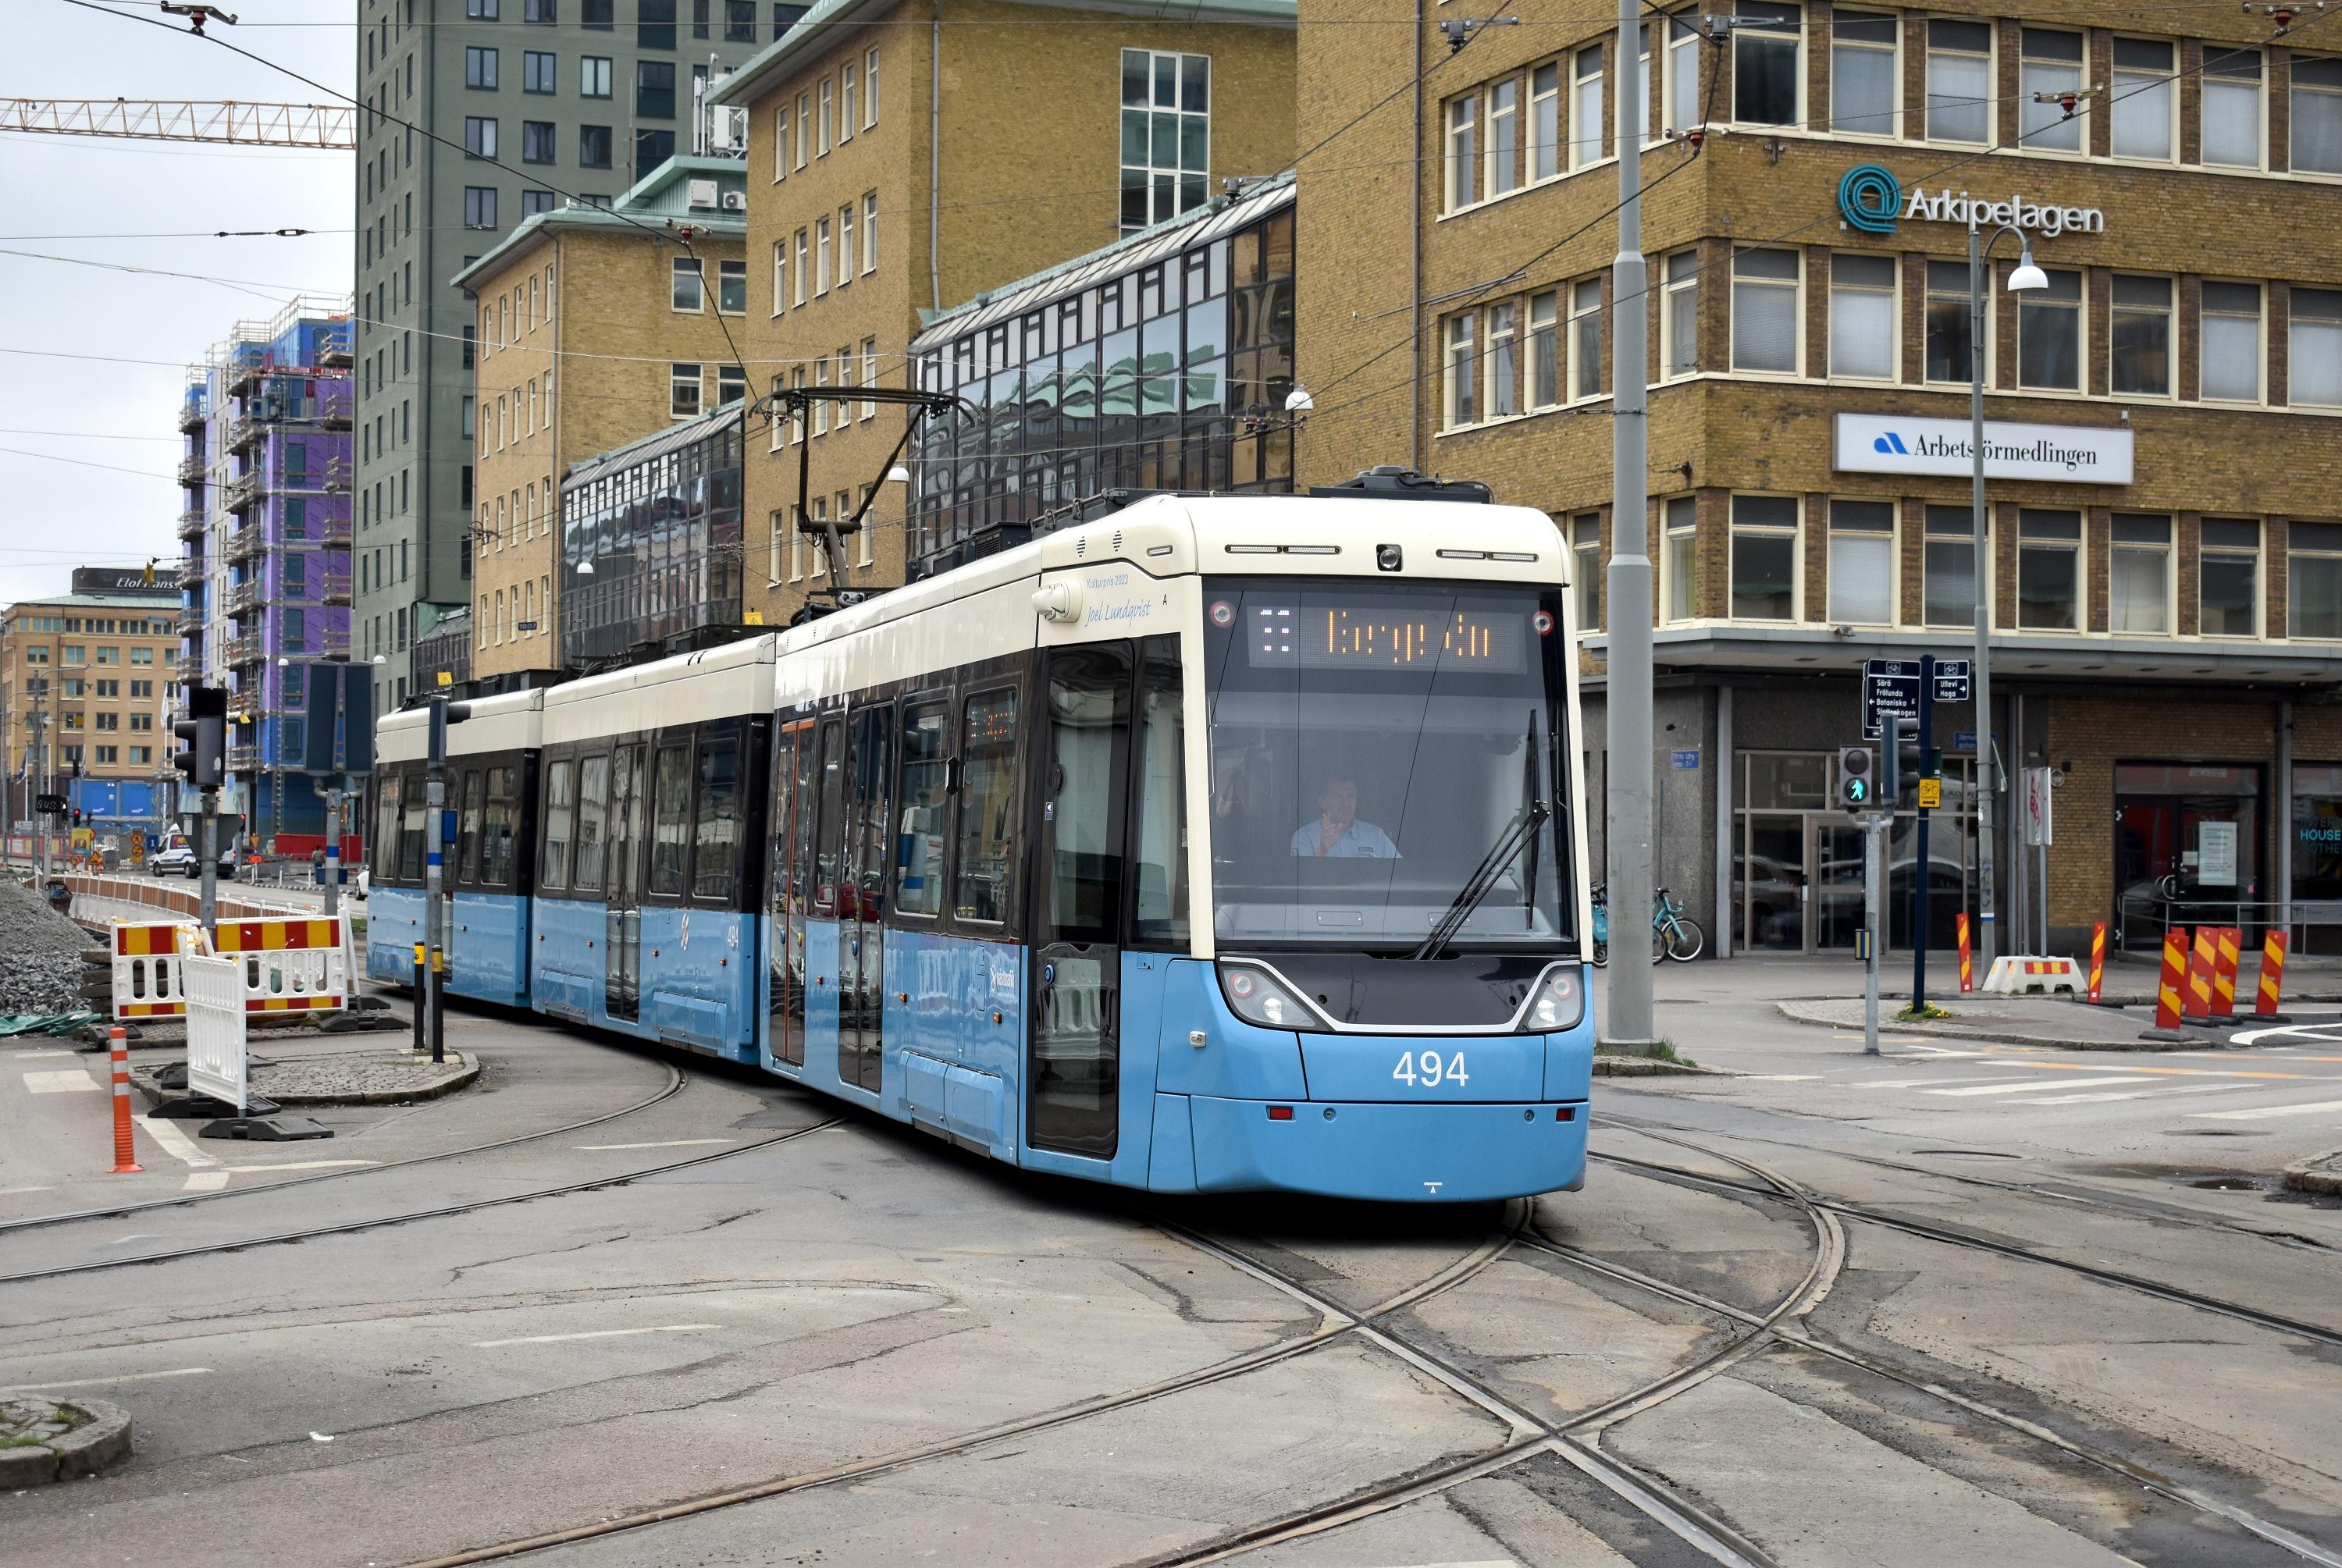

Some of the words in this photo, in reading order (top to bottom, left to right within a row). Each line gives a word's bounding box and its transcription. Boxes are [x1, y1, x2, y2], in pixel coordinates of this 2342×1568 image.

[1904, 187, 2104, 239] Arkipelagen
[1914, 433, 2098, 472] Arbetsörmedlingen
[1087, 576, 1115, 590] Kulturpris
[1115, 574, 1129, 585] 2023
[1162, 594, 1167, 606] A
[1084, 601, 1104, 628] Joel
[1105, 596, 1151, 628] Lundqvist
[1876, 699, 1907, 707] Botaniska
[1940, 690, 1956, 699] Haga
[2300, 829, 2341, 841] HOUSE
[728, 925, 739, 948] 494
[1393, 1051, 1469, 1087] 494
